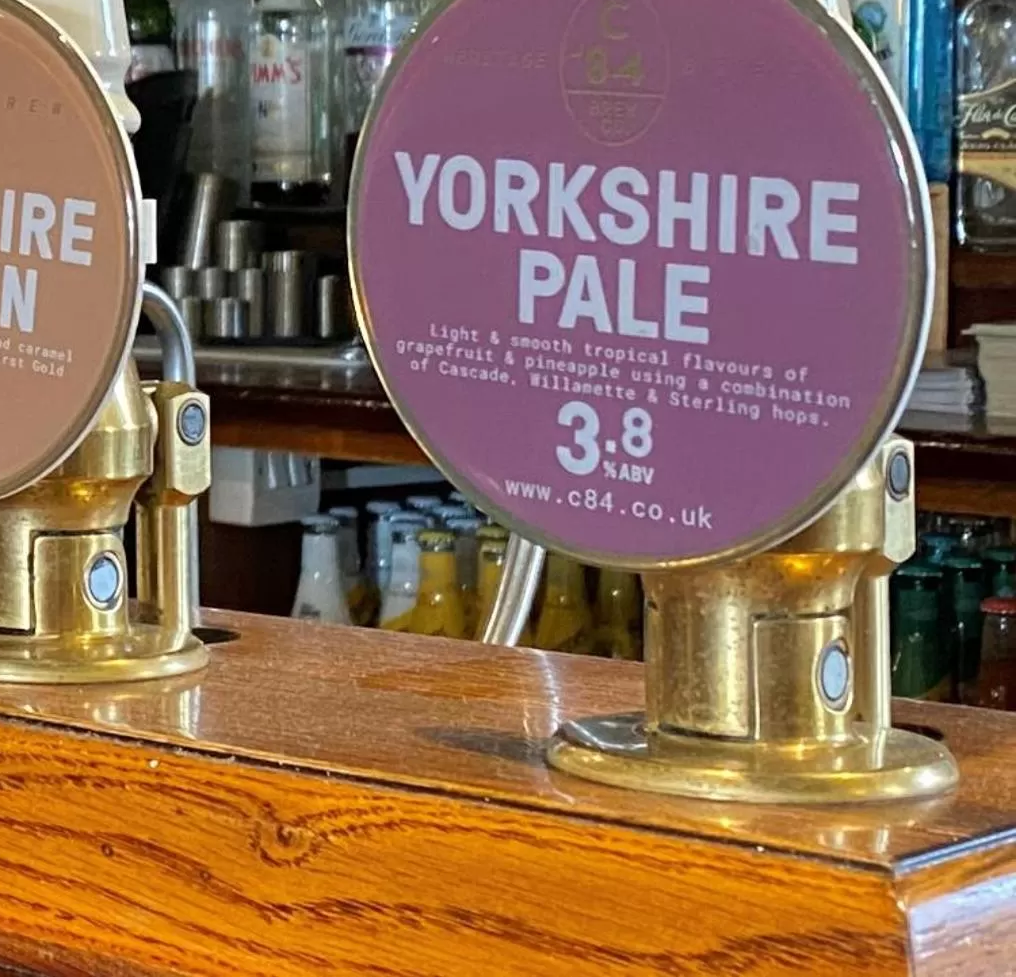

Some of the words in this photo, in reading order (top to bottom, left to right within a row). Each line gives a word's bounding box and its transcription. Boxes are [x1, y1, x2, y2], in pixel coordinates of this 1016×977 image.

[394, 151, 860, 264] YORKSHIRE
[518, 249, 710, 344] PALE
[18, 342, 73, 363] caramel
[32, 359, 66, 377] Gold
[395, 339, 494, 363] grapefruit
[503, 350, 516, 366] &
[524, 355, 621, 380] pineapple
[631, 368, 687, 390] using
[698, 377, 710, 391] a
[720, 378, 852, 410] combination
[430, 323, 479, 343] Light
[489, 330, 501, 345] &
[510, 334, 573, 355] smooth
[584, 342, 669, 367] tropical
[683, 351, 773, 379] flavours
[784, 366, 809, 383] of
[410, 357, 430, 373] of
[528, 372, 637, 401] Willamette
[646, 387, 659, 405] &
[668, 390, 761, 421] Sterling
[771, 404, 830, 428] hops.
[556, 400, 653, 475] 3.8
[505, 479, 713, 530] www.c84.co.uk
[603, 460, 655, 485] %ABV
